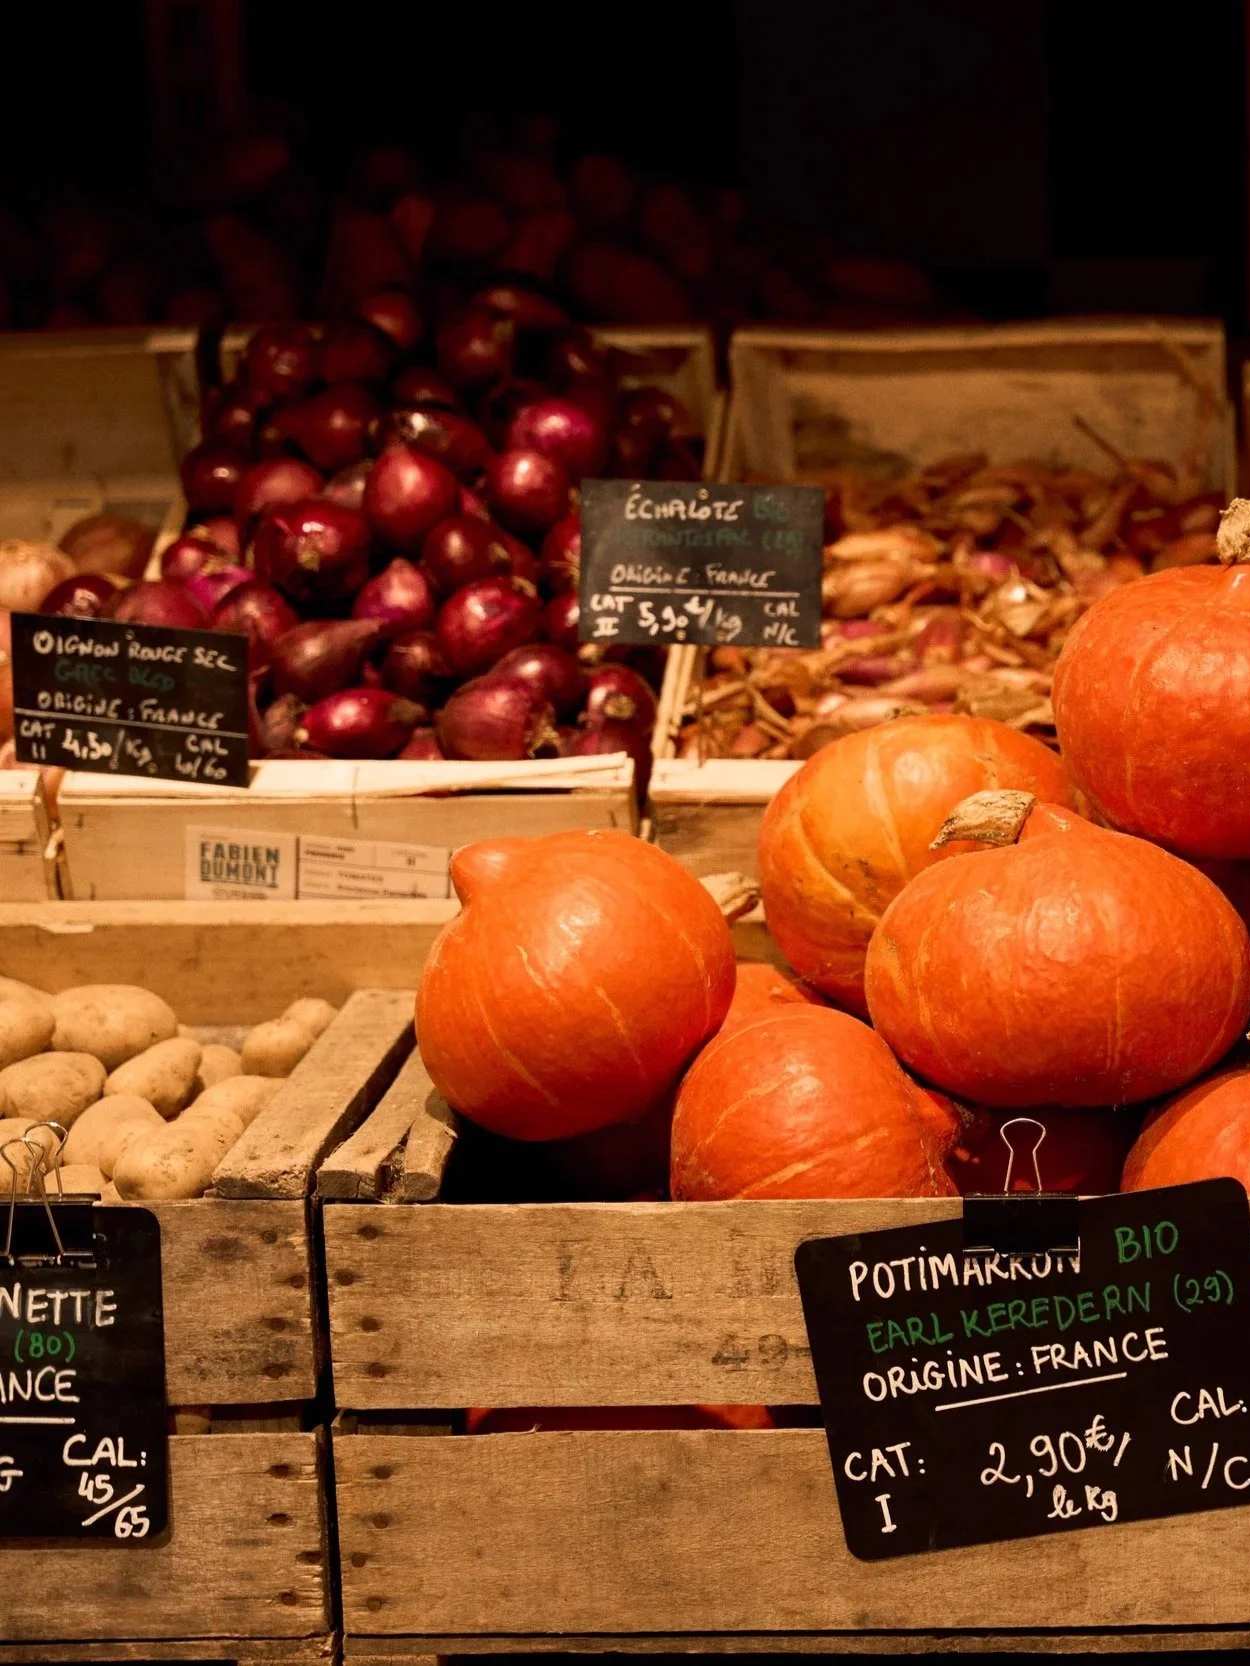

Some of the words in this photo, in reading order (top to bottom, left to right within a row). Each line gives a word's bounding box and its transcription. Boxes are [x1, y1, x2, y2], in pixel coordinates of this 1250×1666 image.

[33, 630, 120, 657] OIGNON
[128, 641, 187, 664] ROUGE
[191, 646, 237, 672] SEC
[1114, 1221, 1179, 1263] BIO
[866, 1312, 954, 1353] EARL
[960, 1282, 1151, 1337] KEREDERN
[1173, 1270, 1234, 1313] (29)
[14, 1330, 76, 1363] (80)
[1031, 1327, 1168, 1374] FRANCE
[62, 1434, 147, 1467] CAL:
[875, 1494, 897, 1533] I
